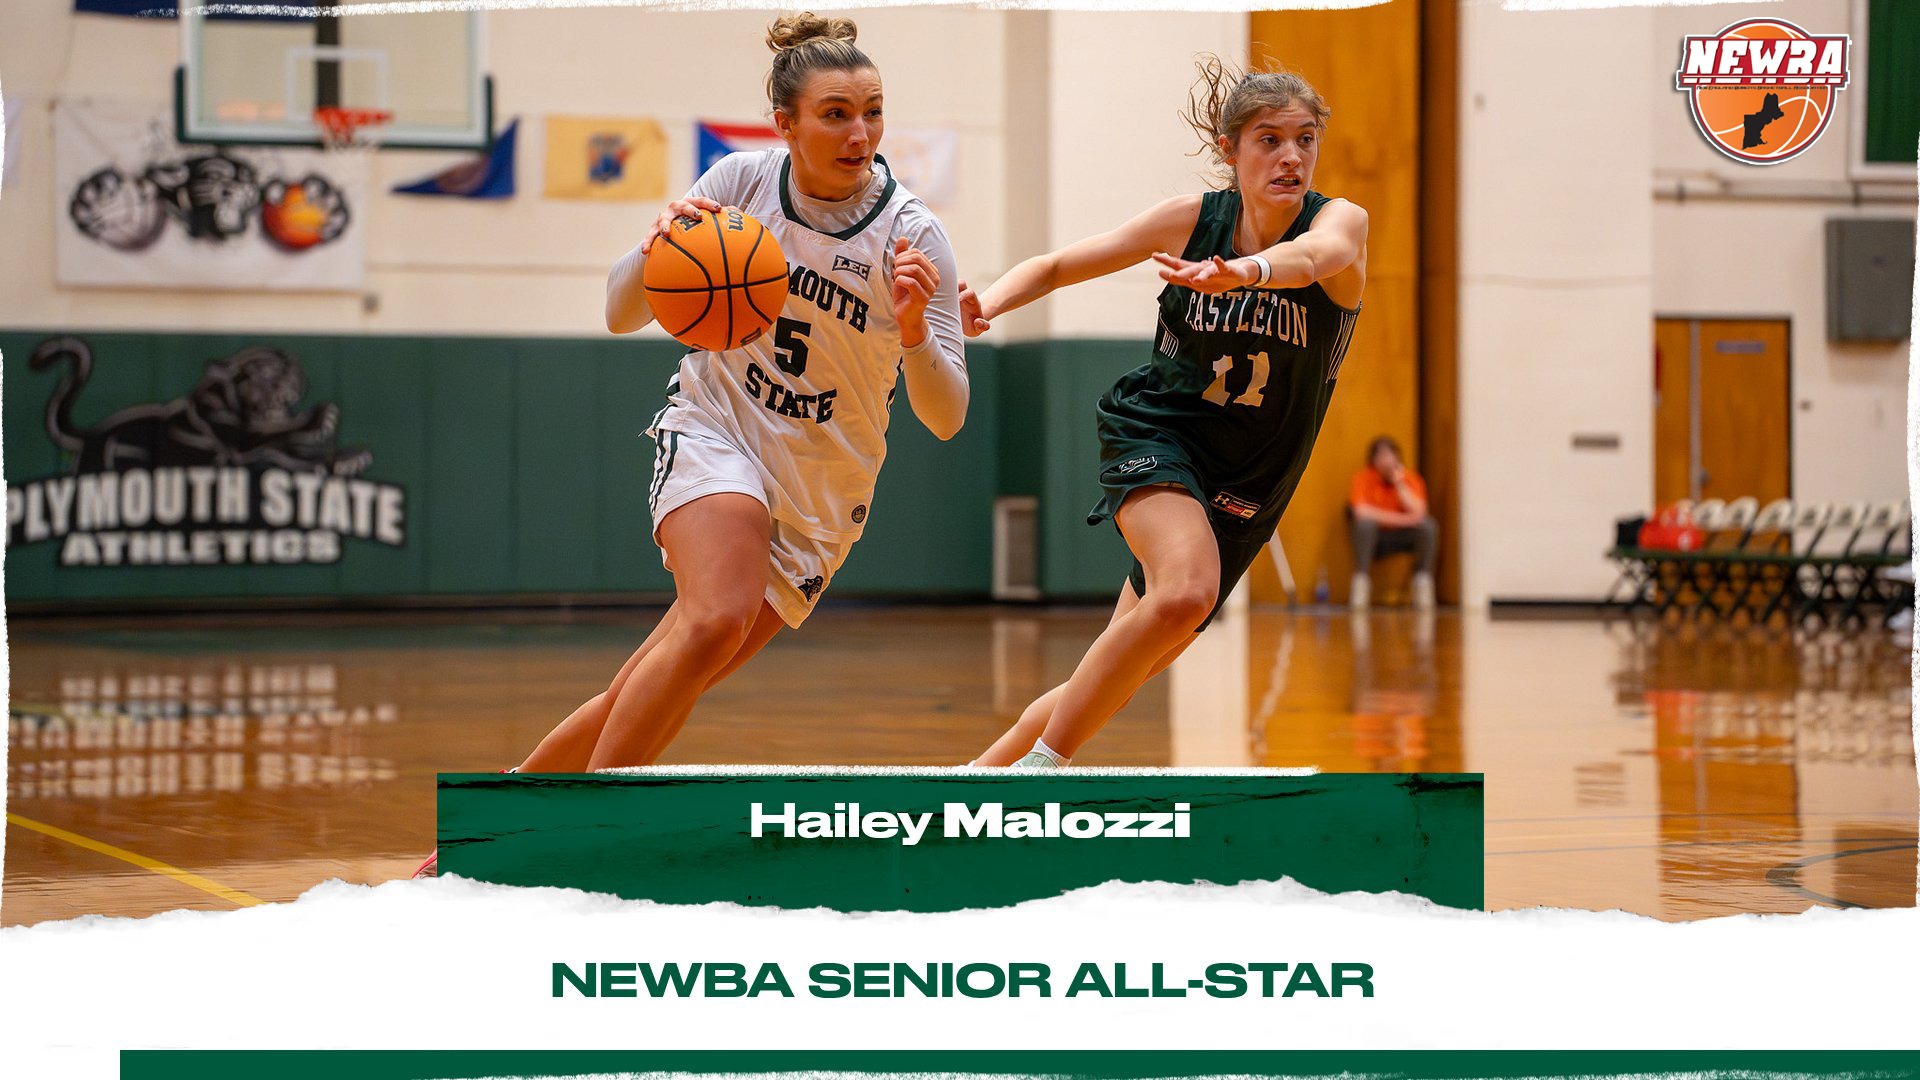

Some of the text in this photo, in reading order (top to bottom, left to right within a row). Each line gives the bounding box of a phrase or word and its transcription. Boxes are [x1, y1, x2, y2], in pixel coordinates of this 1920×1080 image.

[834, 256, 870, 279] LEC
[775, 316, 811, 378] 5
[1185, 291, 1308, 348] CASTLETON
[745, 363, 837, 424] STATE
[6, 467, 404, 547] PLYMOUTH STATE
[61, 530, 341, 566] ATHLETICS
